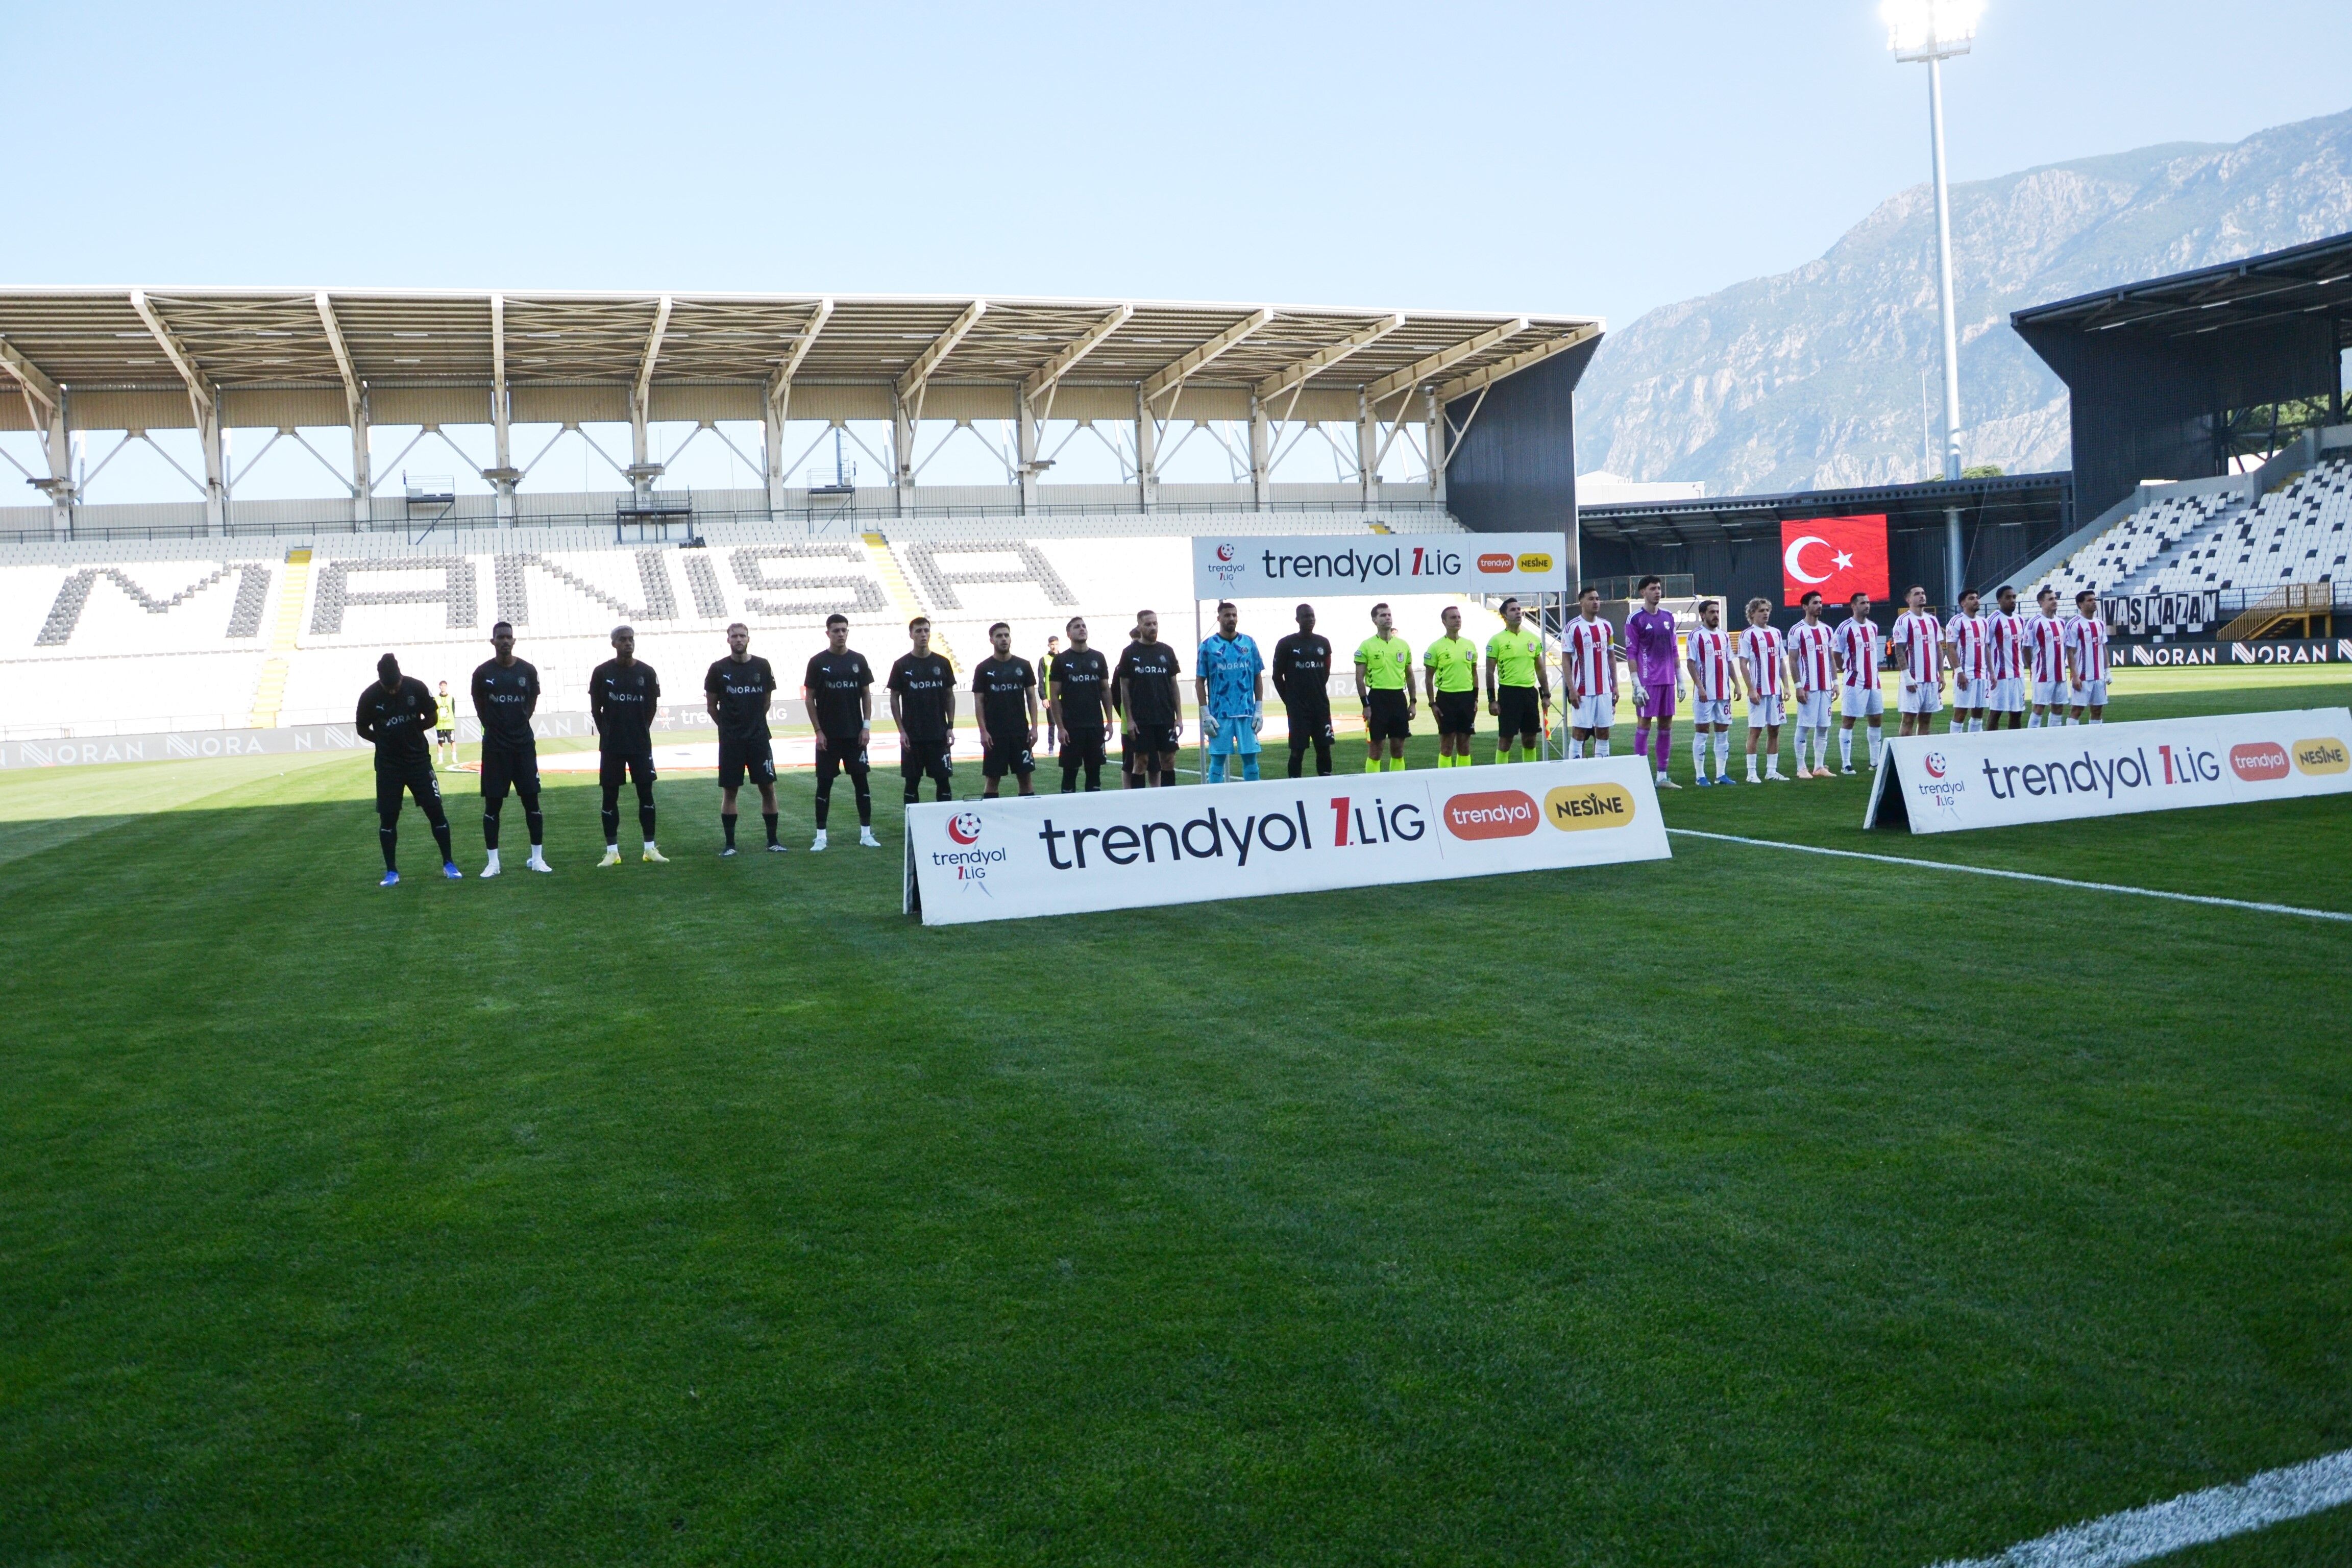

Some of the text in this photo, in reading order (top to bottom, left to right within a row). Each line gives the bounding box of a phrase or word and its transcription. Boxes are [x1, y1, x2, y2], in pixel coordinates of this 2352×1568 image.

[1208, 564, 1245, 573] trendyol
[1262, 548, 1400, 583] trendyol
[1481, 556, 1511, 567] trendyol
[2148, 593, 2216, 626] KAZAN
[2133, 645, 2216, 666] NORAN
[726, 685, 763, 695] NORAN
[1776, 702, 1785, 714] 18
[20, 741, 144, 766] NORAN
[2235, 752, 2285, 769] trendyol
[1982, 747, 2152, 800] trendyol
[1919, 780, 1965, 795] trendyol
[1452, 802, 1531, 825] trendyol
[1039, 800, 1312, 870] trendyol
[932, 847, 1007, 866] trendyol
